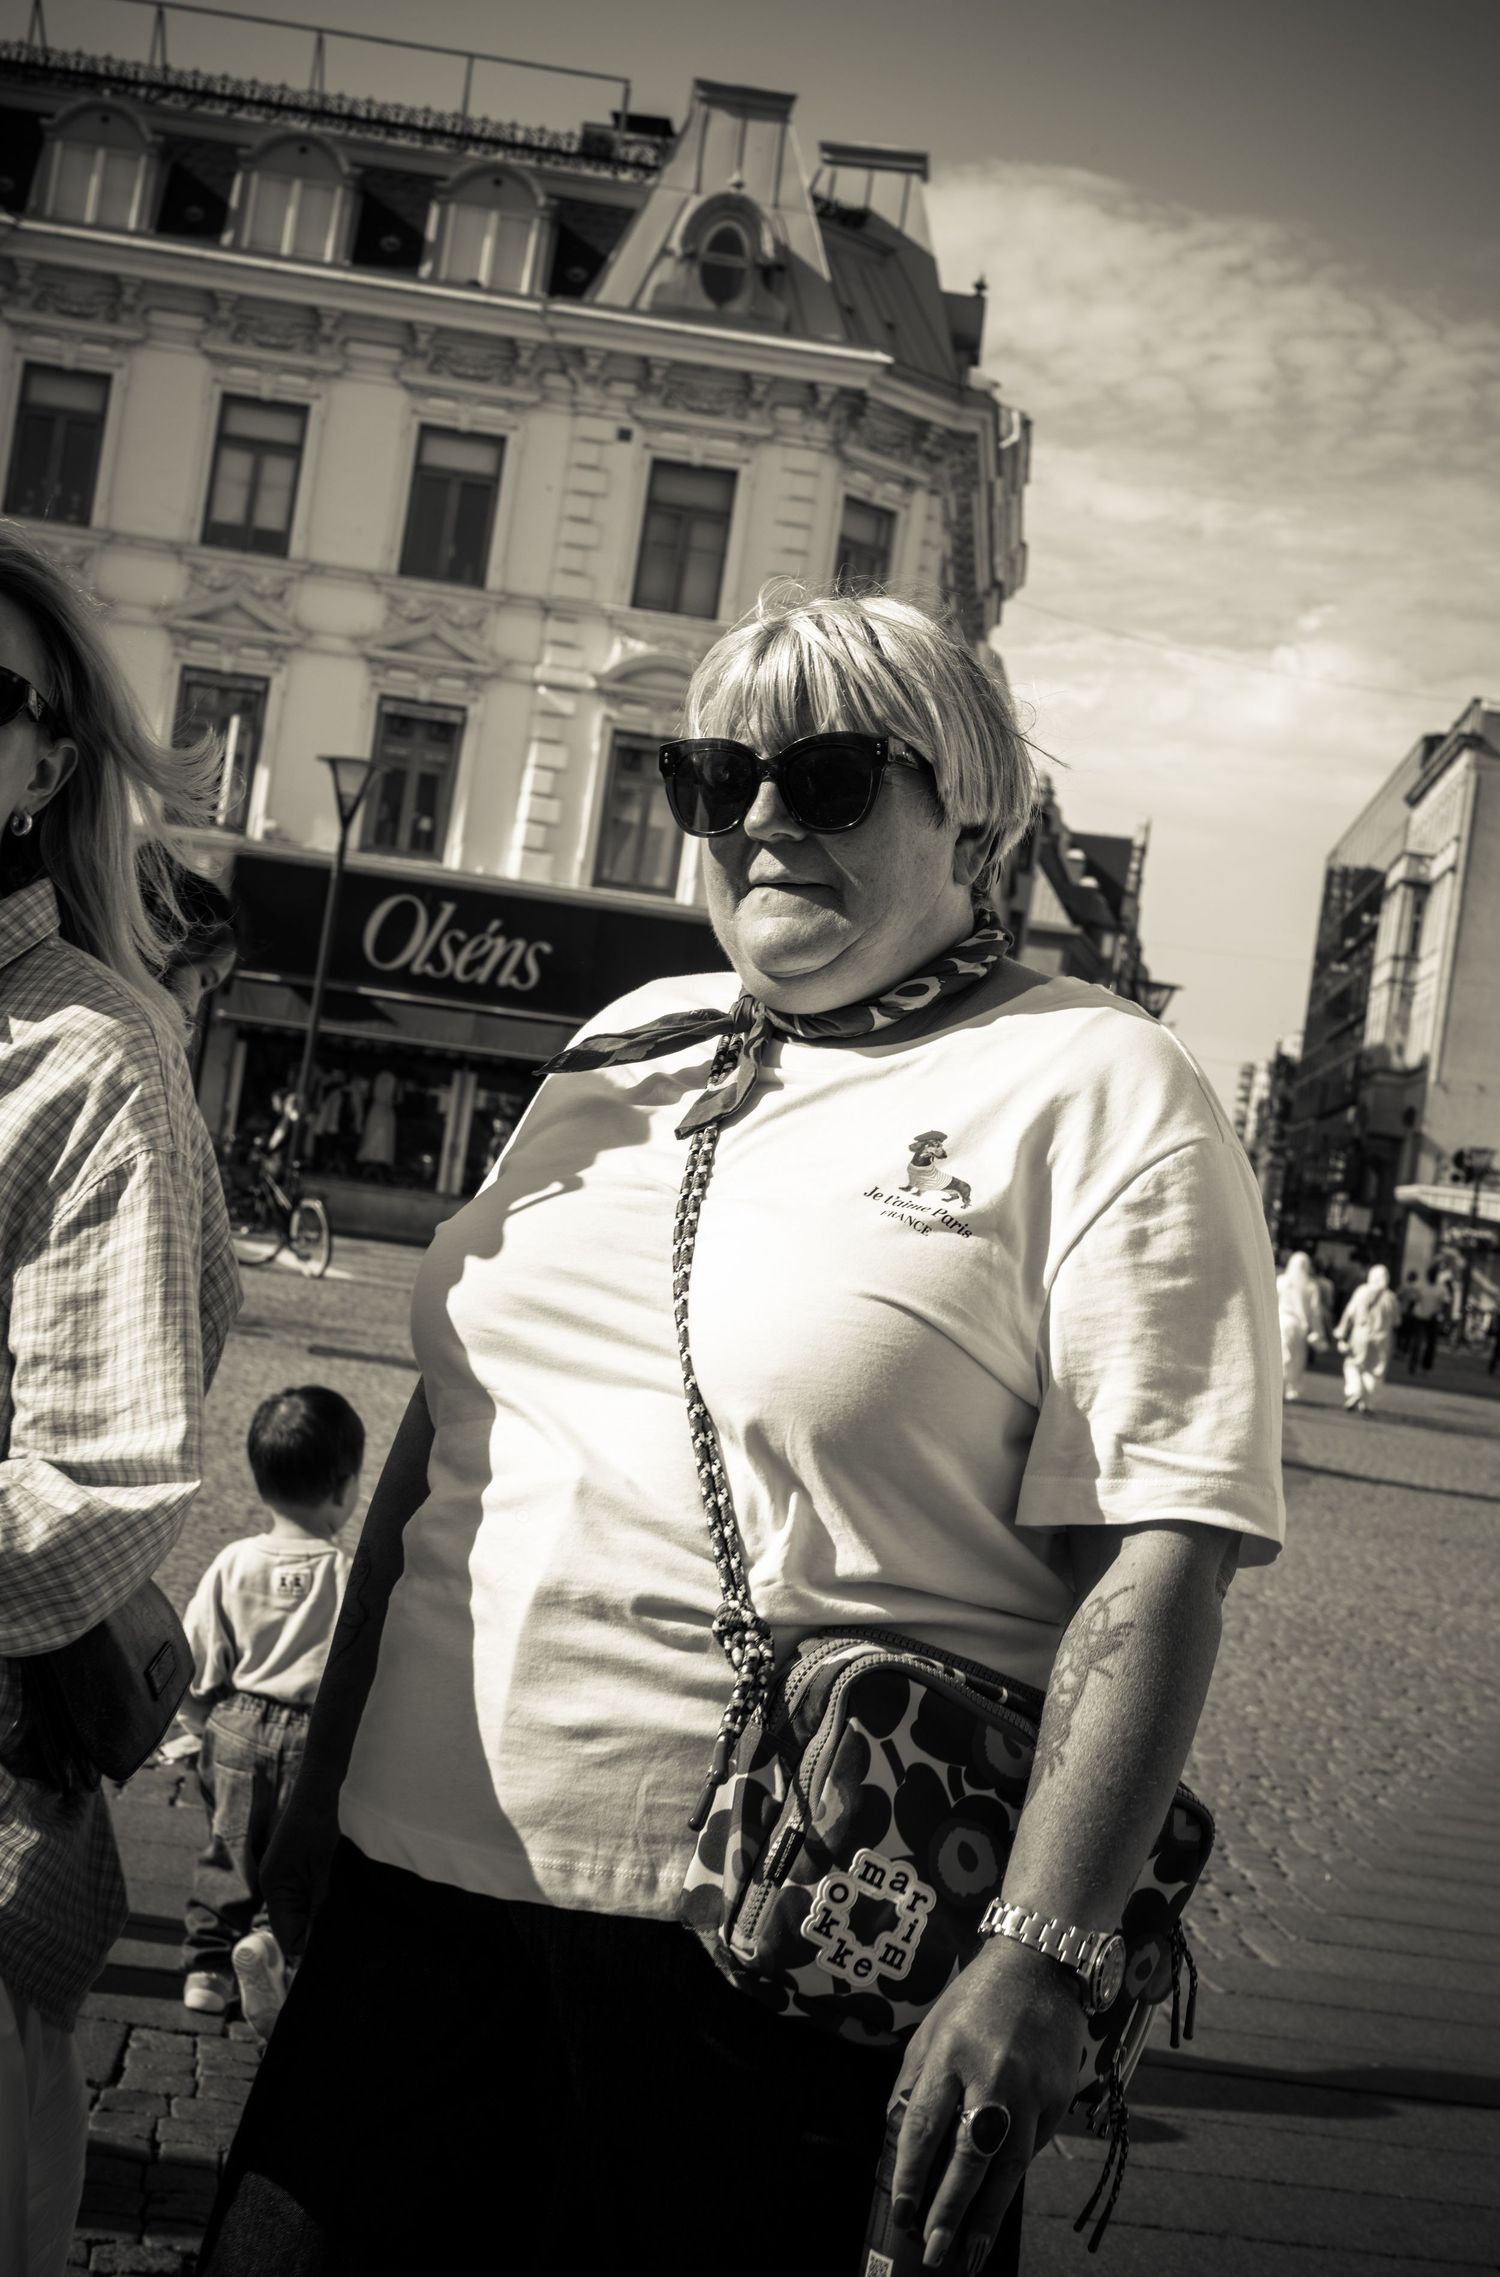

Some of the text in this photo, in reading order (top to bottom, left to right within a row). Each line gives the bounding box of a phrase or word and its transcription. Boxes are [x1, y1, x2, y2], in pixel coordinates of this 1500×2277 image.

[363, 893, 553, 991] Olséns
[863, 1186, 973, 1239] Je t'aime Paris
[880, 1209, 933, 1237] FRANCE
